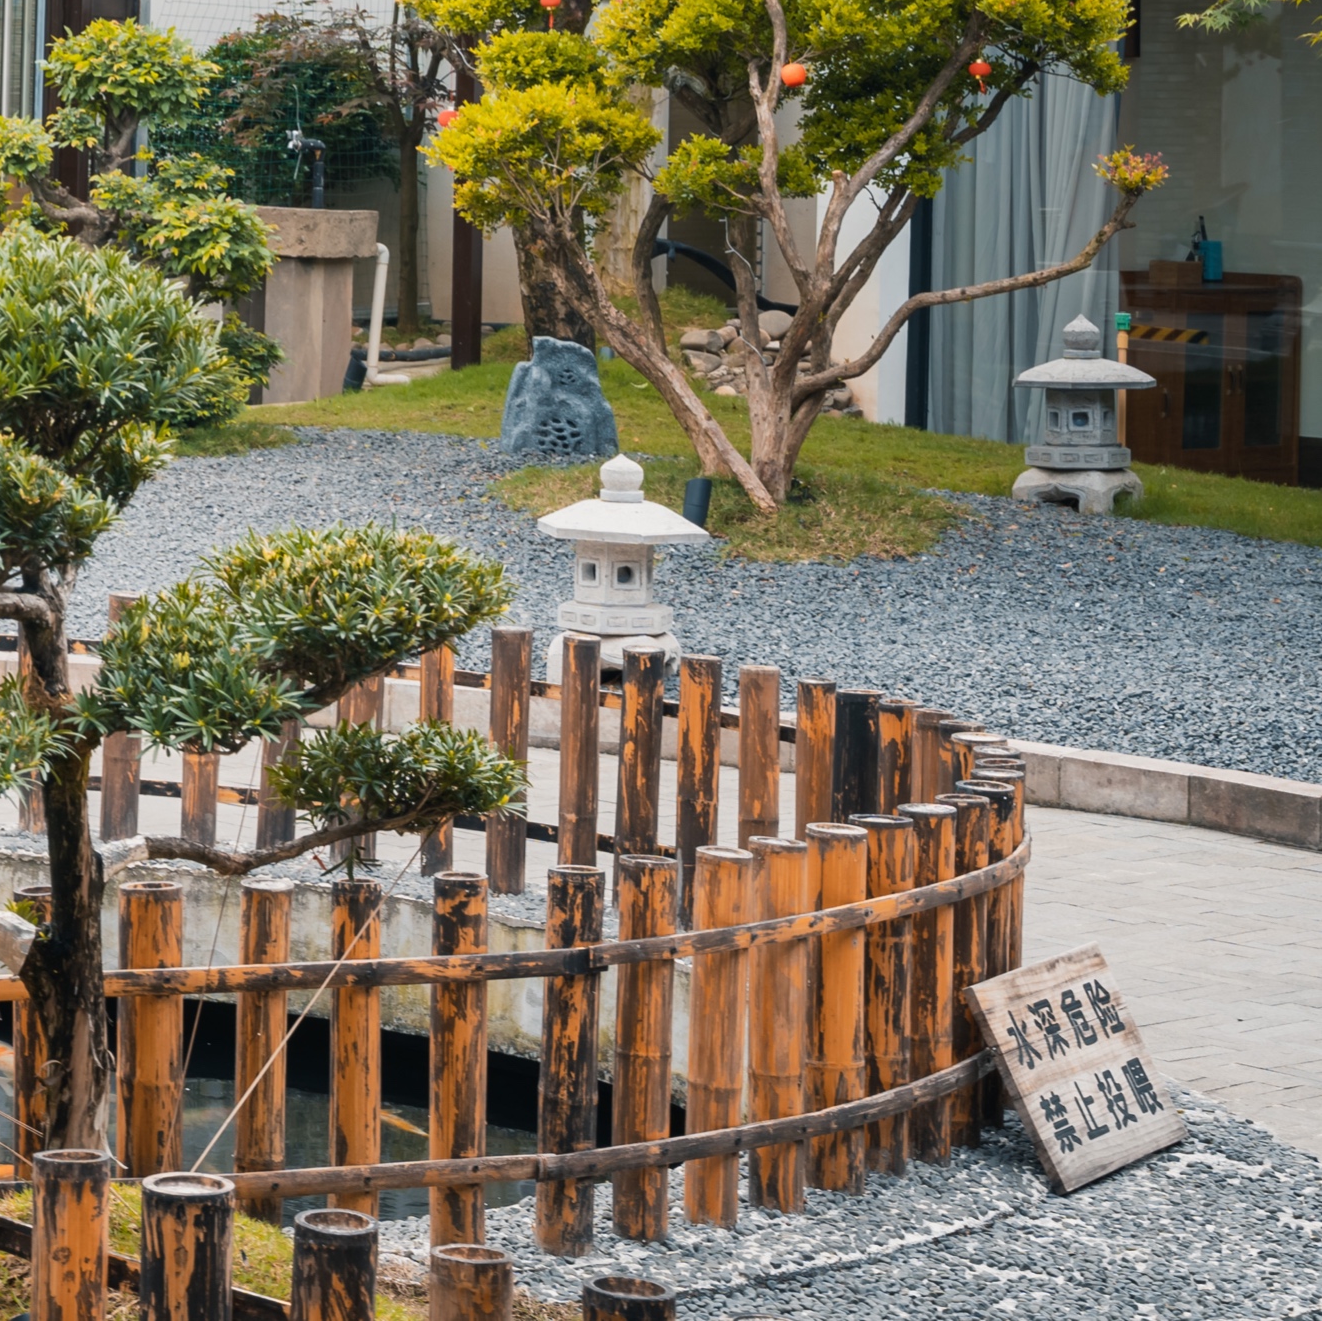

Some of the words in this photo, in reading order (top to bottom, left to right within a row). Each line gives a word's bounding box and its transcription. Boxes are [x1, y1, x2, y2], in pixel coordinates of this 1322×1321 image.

[1006, 978, 1126, 1070] 水深危险
[1039, 1057, 1164, 1154] 禁止投喂
